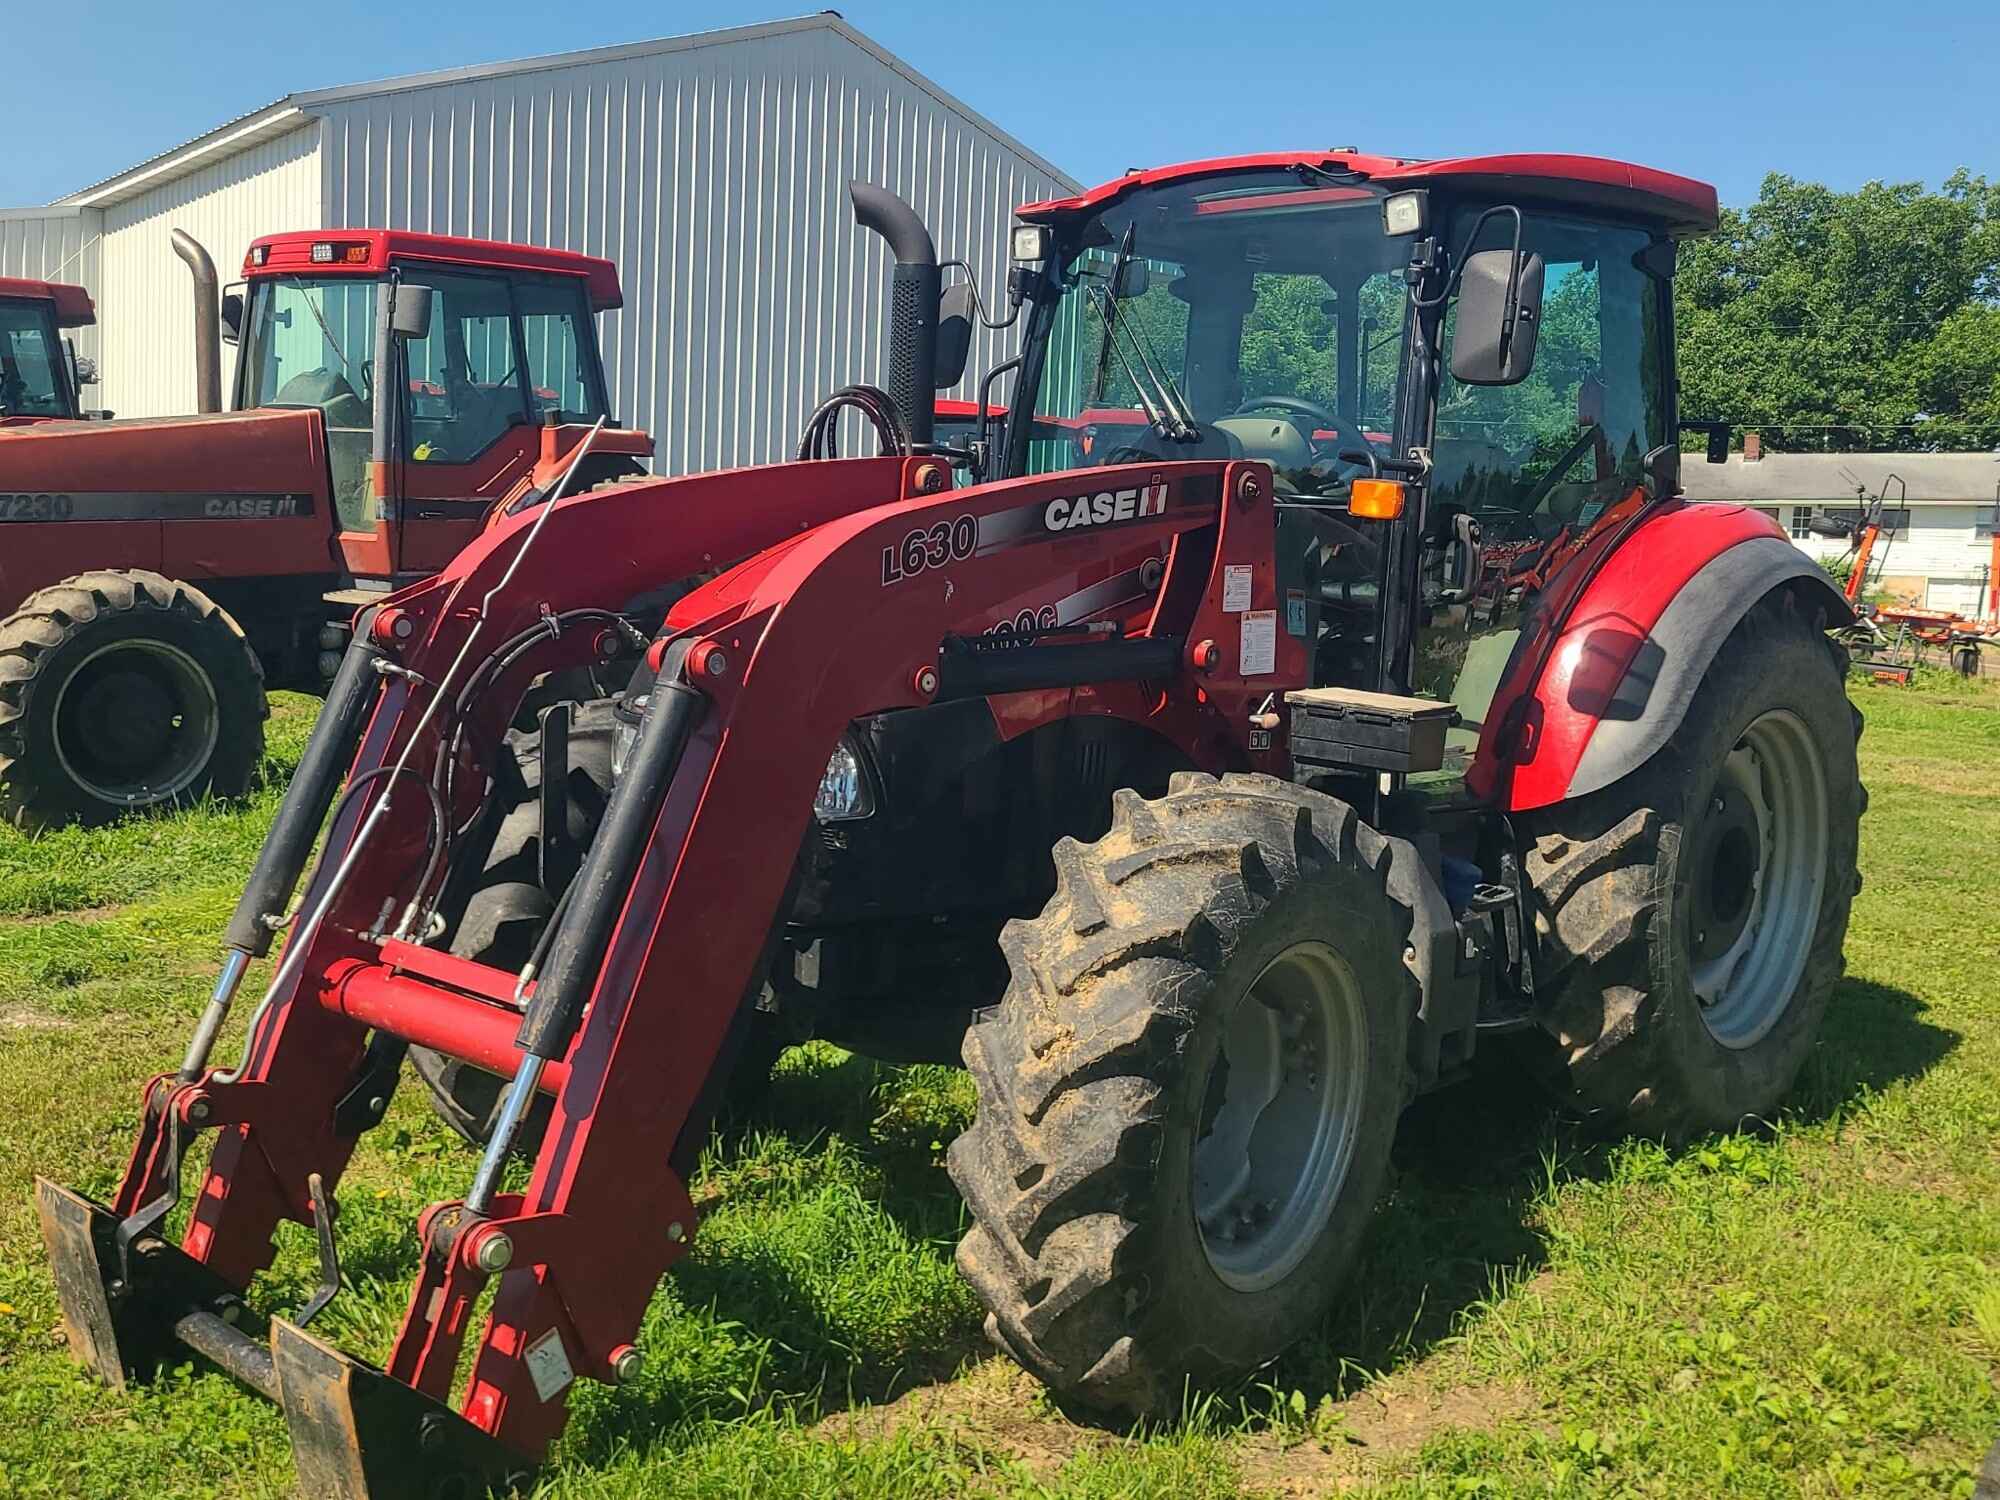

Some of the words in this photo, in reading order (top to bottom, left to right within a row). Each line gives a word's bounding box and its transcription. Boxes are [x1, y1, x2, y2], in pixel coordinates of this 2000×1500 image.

[205, 499, 272, 516] CASE
[1044, 488, 1137, 531] CASE
[881, 513, 979, 586] L630
